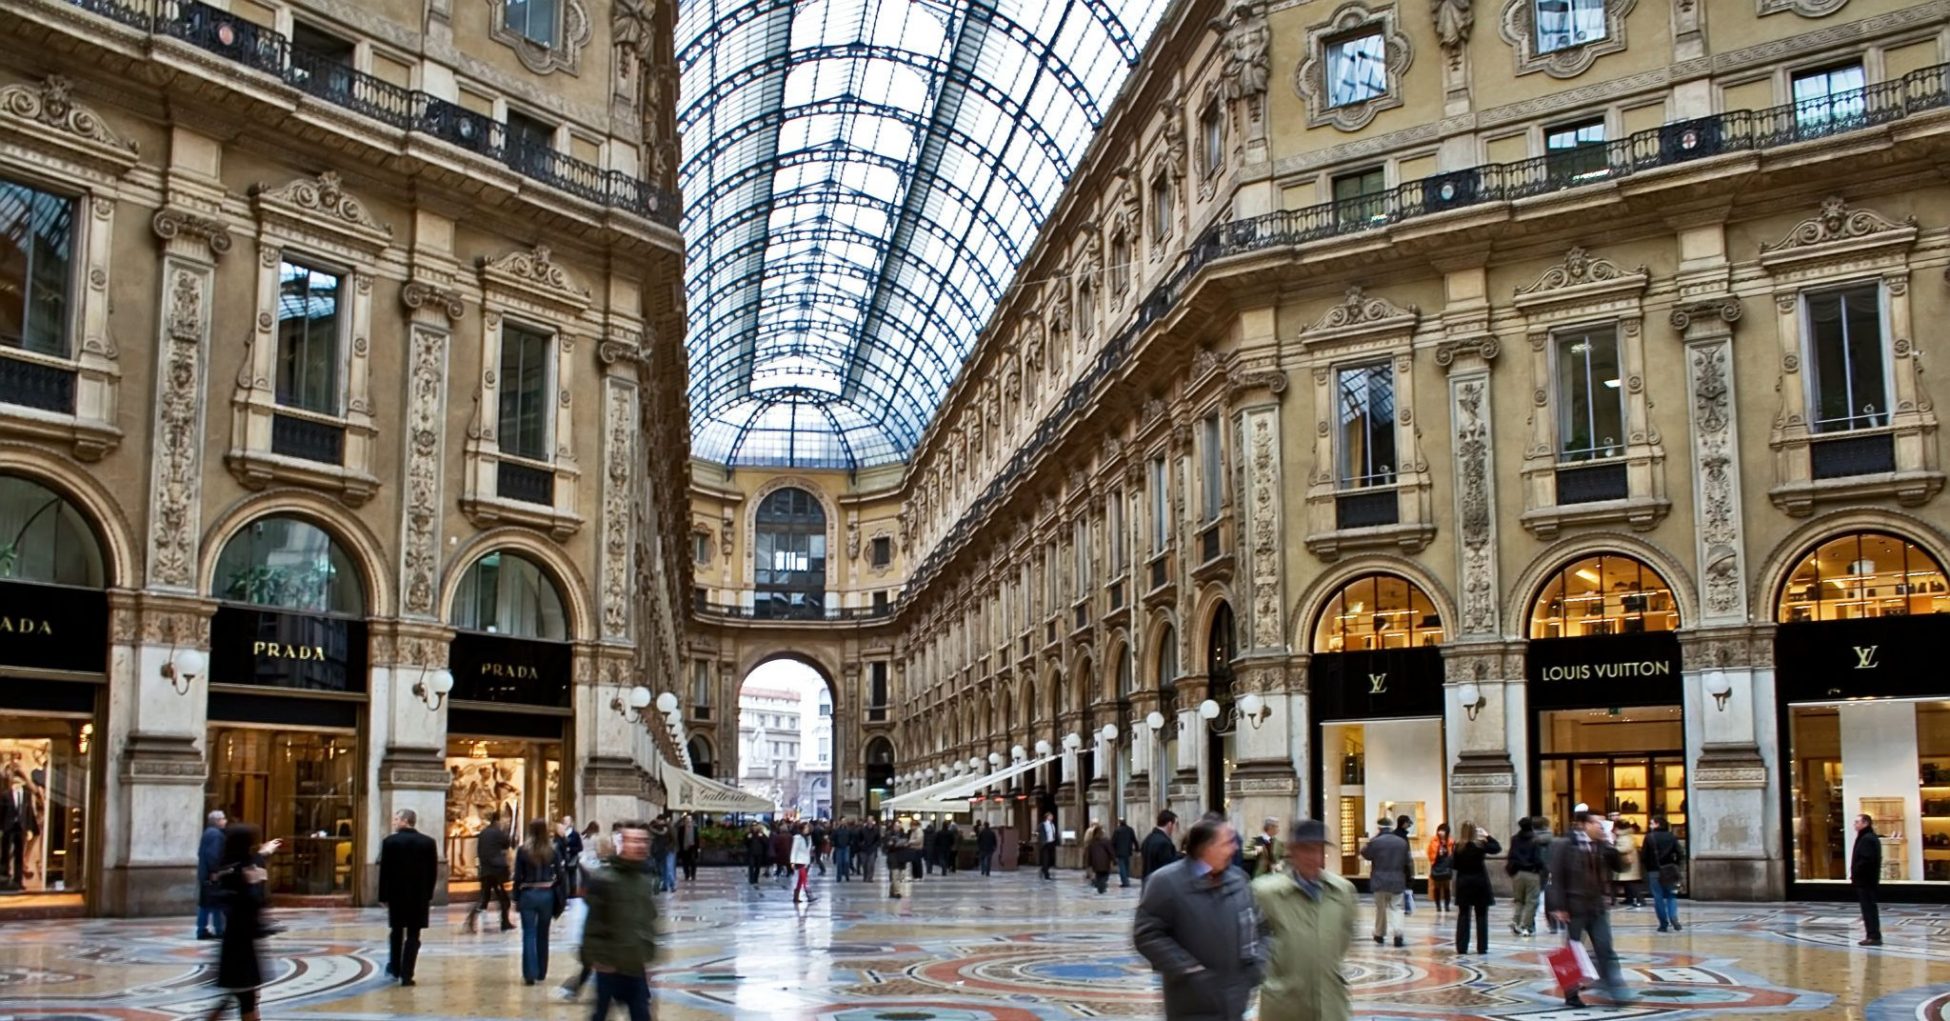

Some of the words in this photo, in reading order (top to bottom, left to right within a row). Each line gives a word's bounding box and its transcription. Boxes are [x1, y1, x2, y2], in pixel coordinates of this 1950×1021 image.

[253, 641, 325, 661] PRADA
[481, 663, 538, 680] PRADA
[1542, 665, 1591, 681] LOUIS
[1594, 660, 1670, 678] VUITTON
